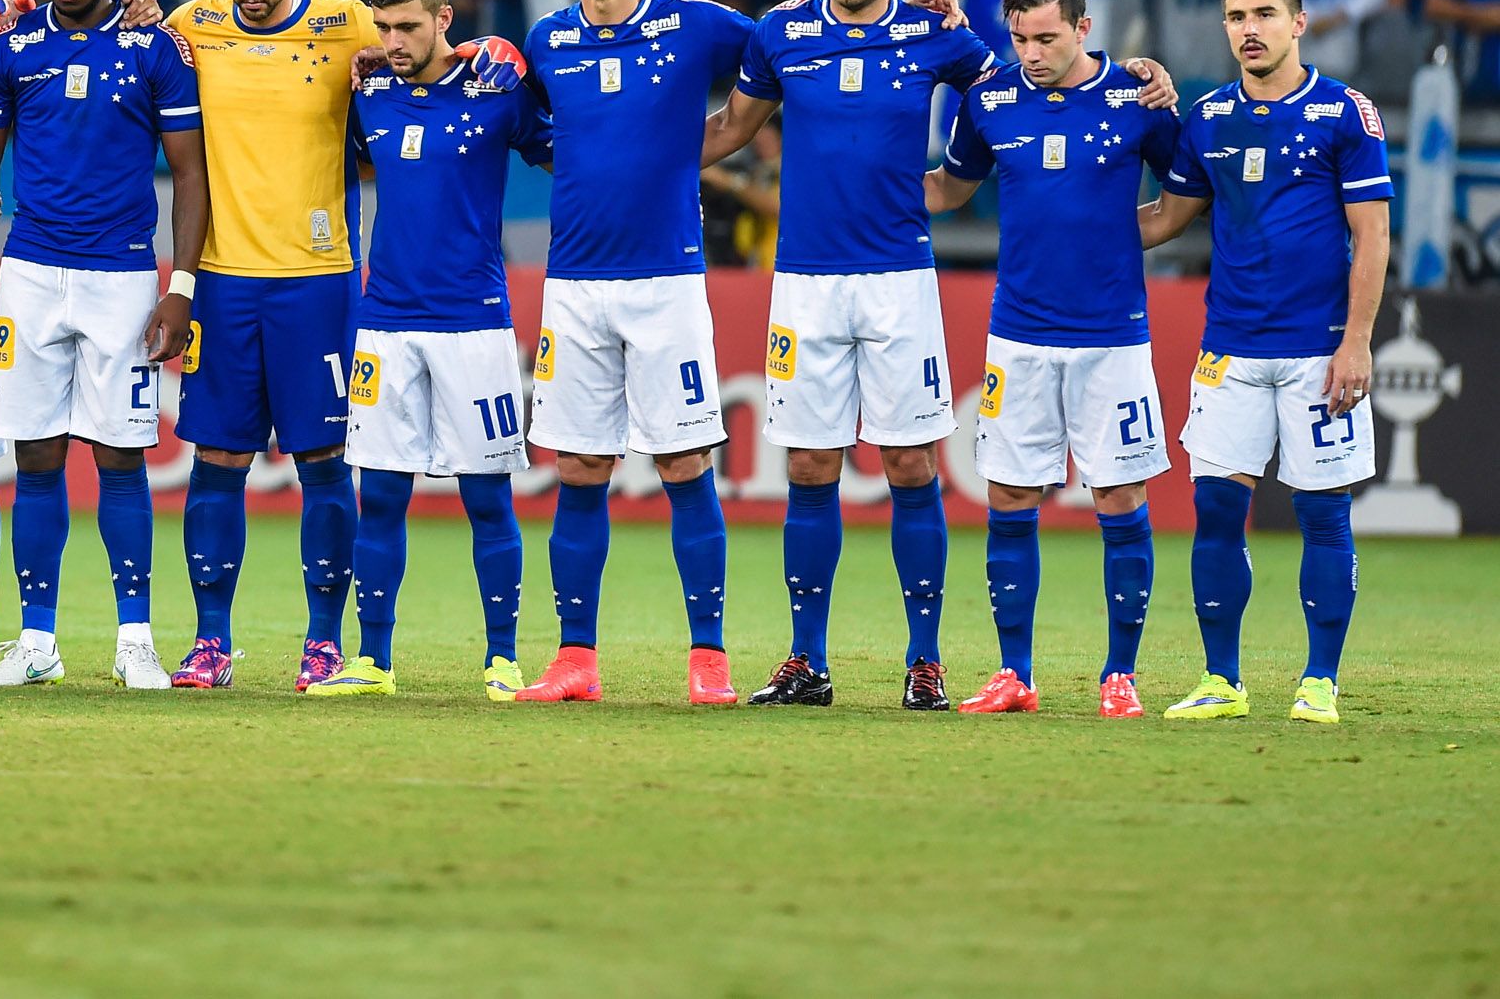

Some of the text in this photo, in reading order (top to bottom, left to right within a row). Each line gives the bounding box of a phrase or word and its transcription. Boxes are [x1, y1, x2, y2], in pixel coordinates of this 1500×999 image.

[193, 7, 228, 23] cemil
[307, 12, 347, 26] cemil
[640, 13, 681, 31] cemil
[550, 27, 581, 41] cemil
[785, 20, 823, 34] cemil
[889, 20, 930, 35] cemil
[8, 28, 46, 44] cemil
[116, 31, 155, 47] cemil
[196, 43, 228, 52] PENALTY
[554, 65, 588, 76] PENALTY
[783, 64, 821, 74] PENALTY
[19, 72, 53, 83] PENALTY
[980, 87, 1018, 101] cemil
[1202, 99, 1236, 112] cemil
[1304, 102, 1345, 115] cemil
[991, 141, 1024, 151] PENALTY
[540, 335, 551, 359] 9
[323, 353, 347, 399] 1
[679, 360, 705, 406] 9
[923, 355, 941, 400] 4
[324, 415, 349, 424] PENA
[473, 392, 519, 442] 10
[914, 408, 946, 421] PENALTY
[1117, 395, 1156, 446] 21
[676, 416, 715, 428] PENALTY
[484, 448, 522, 460] PENALTY
[1114, 451, 1153, 462] PENALTY
[1315, 452, 1353, 465] PENALTY
